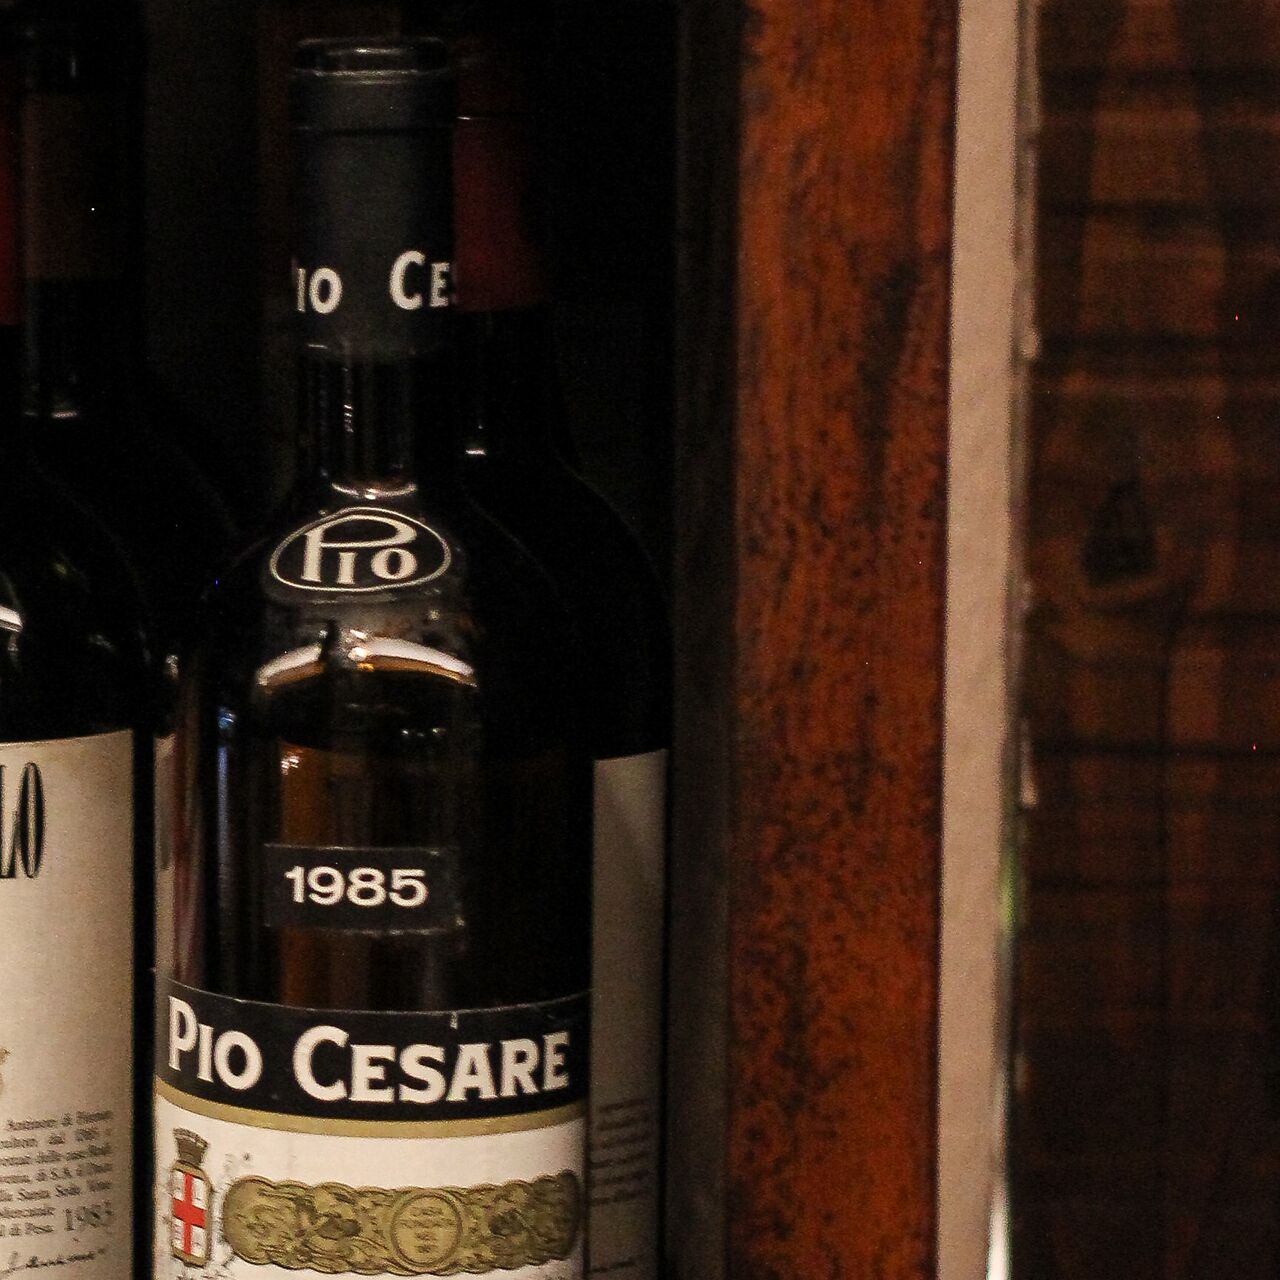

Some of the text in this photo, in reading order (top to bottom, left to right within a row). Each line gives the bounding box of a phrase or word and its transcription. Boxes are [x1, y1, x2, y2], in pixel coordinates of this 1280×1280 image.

[293, 250, 455, 315] IO CE
[284, 865, 430, 908] 1985
[167, 995, 572, 1104] PIO CESARE
